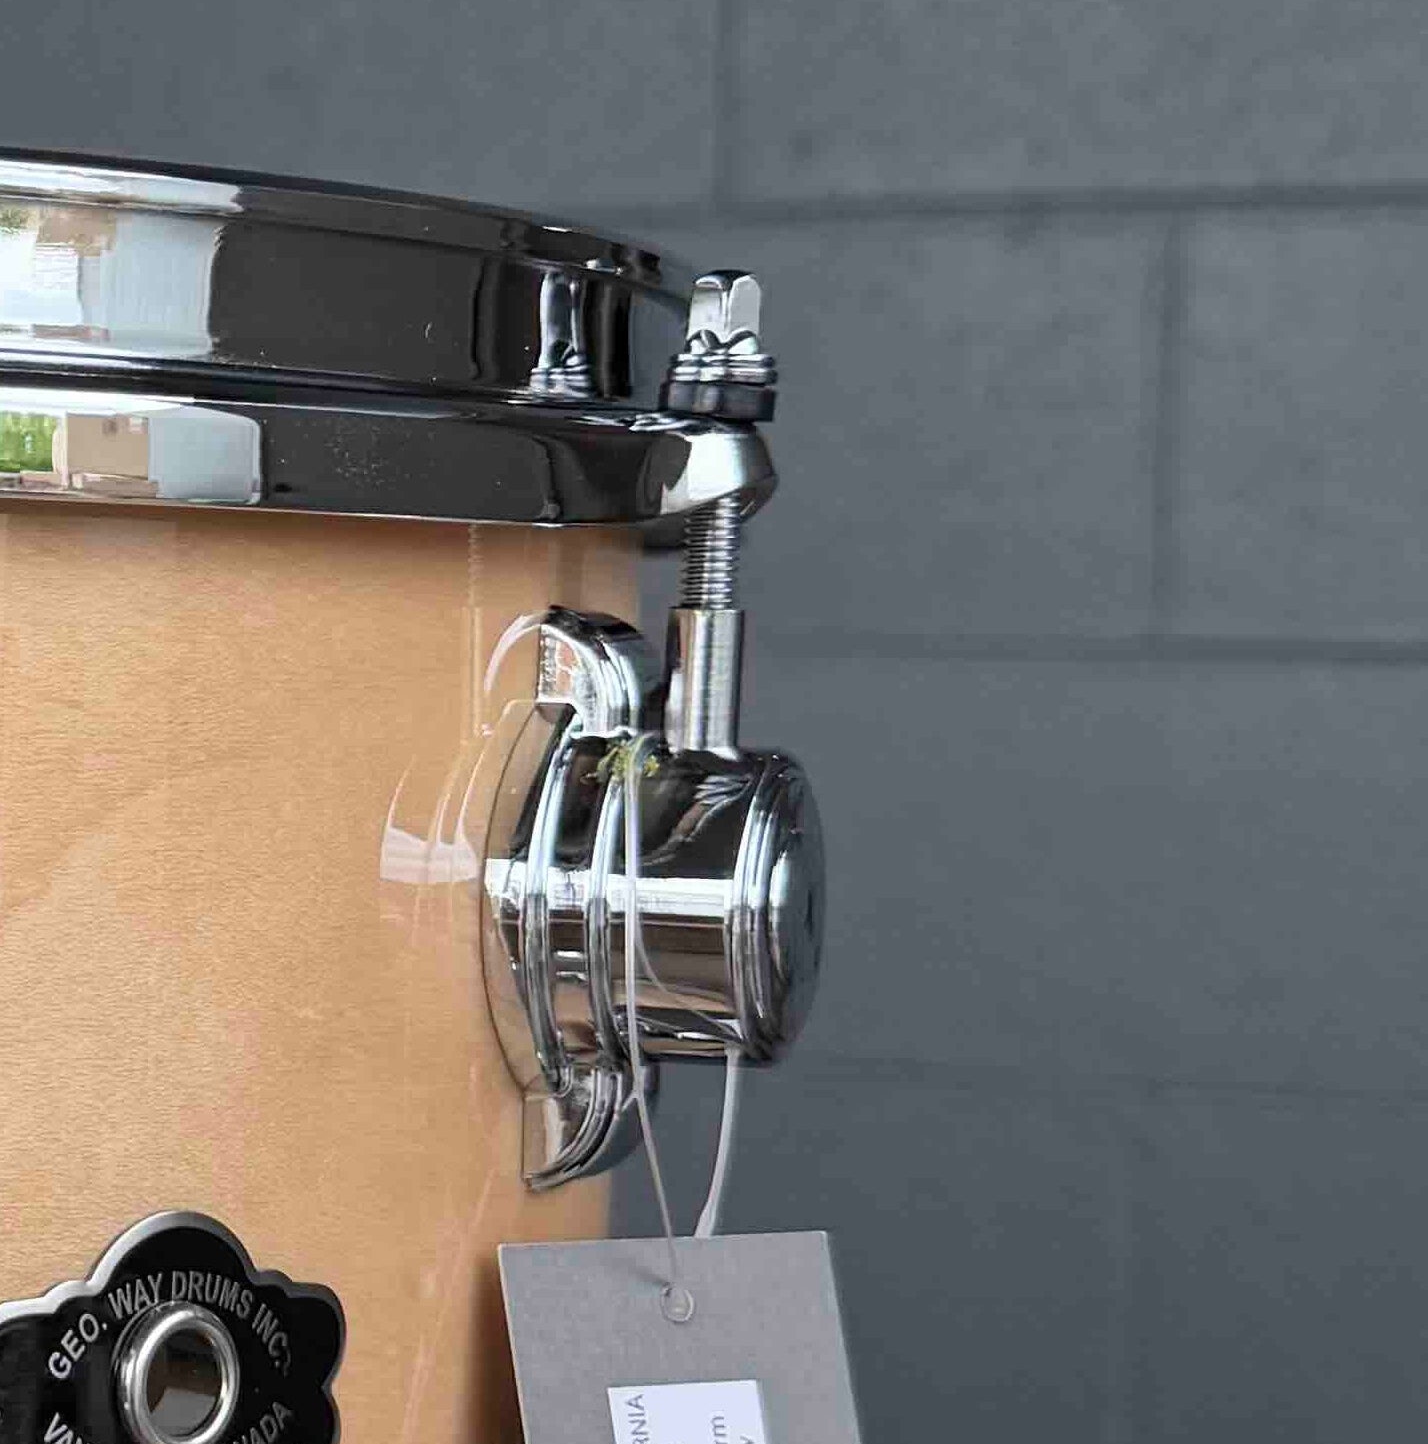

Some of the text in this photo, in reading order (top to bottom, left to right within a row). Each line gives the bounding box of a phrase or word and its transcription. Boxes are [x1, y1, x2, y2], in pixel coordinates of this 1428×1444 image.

[48, 1313, 108, 1379] GEO.
[108, 1273, 163, 1319] WAY
[172, 1270, 253, 1318] DRUMS
